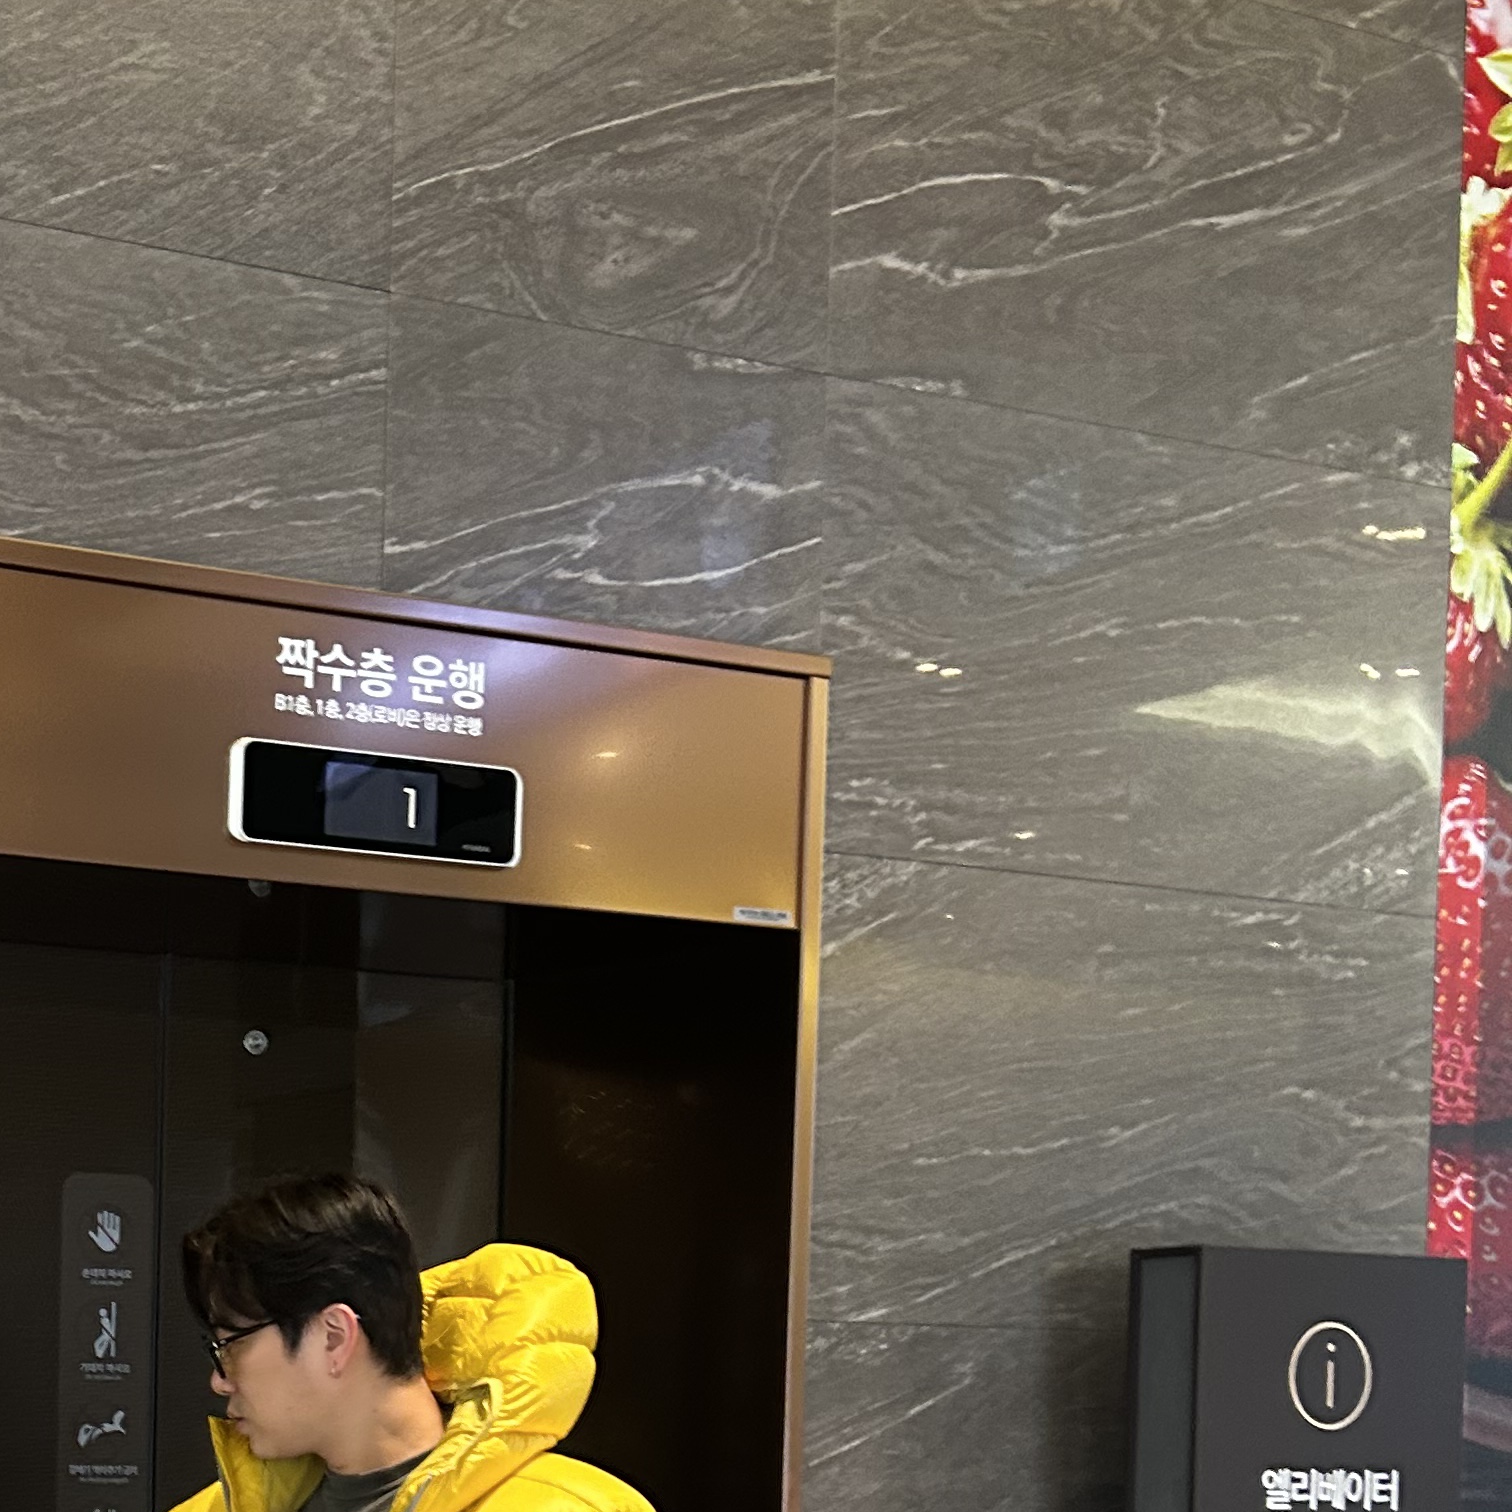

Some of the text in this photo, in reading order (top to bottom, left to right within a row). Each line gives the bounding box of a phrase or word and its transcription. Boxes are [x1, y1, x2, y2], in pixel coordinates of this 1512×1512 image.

[276, 636, 487, 710] 짝수층 운행
[453, 714, 484, 737] 운행
[402, 787, 417, 829] 1
[1261, 1468, 1400, 1512] 엘리베이터
